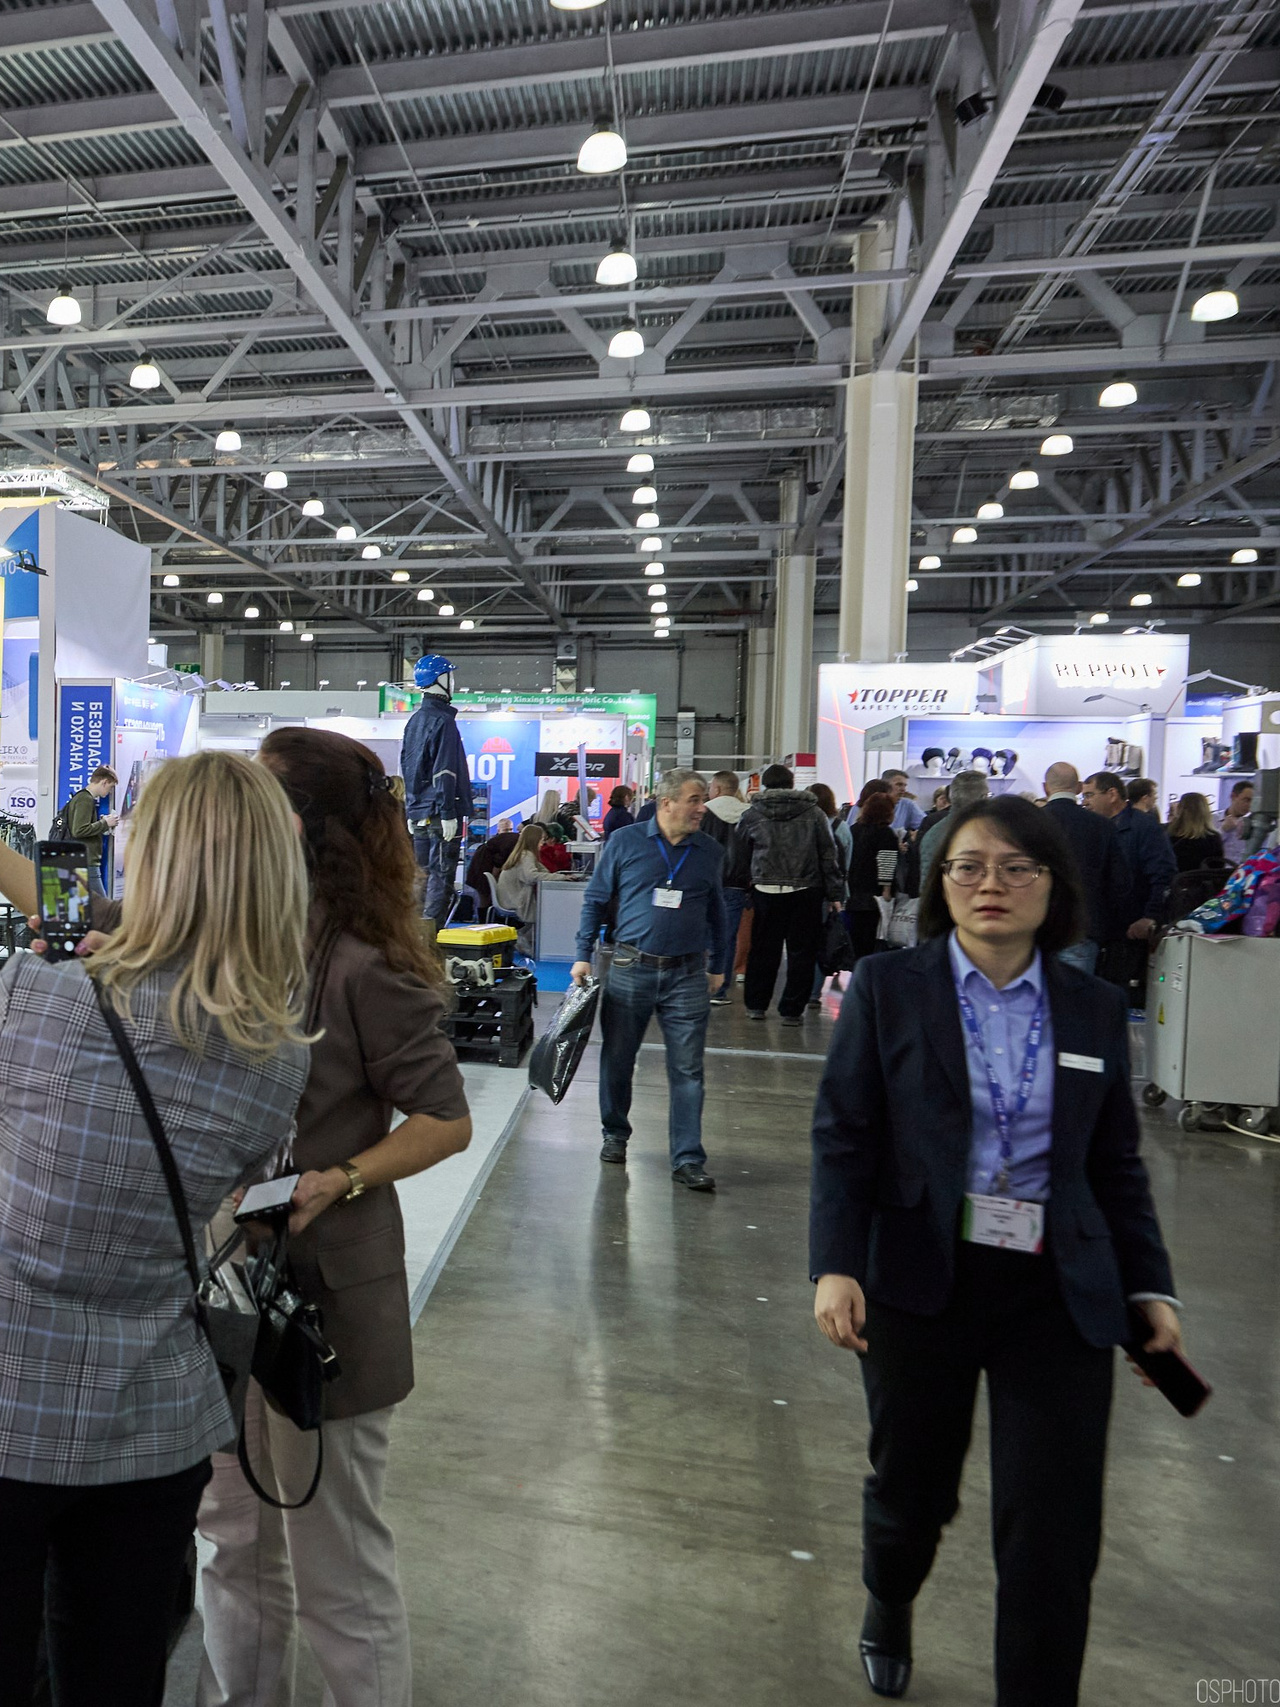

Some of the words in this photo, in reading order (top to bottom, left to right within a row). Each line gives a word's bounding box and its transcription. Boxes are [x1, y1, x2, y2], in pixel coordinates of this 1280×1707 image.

[860, 689, 948, 703] TOPPER
[72, 702, 85, 711] И
[70, 716, 84, 771] ОХРАНА
[87, 702, 103, 806] БЕЗОПАСН
[10, 797, 36, 808] ISO
